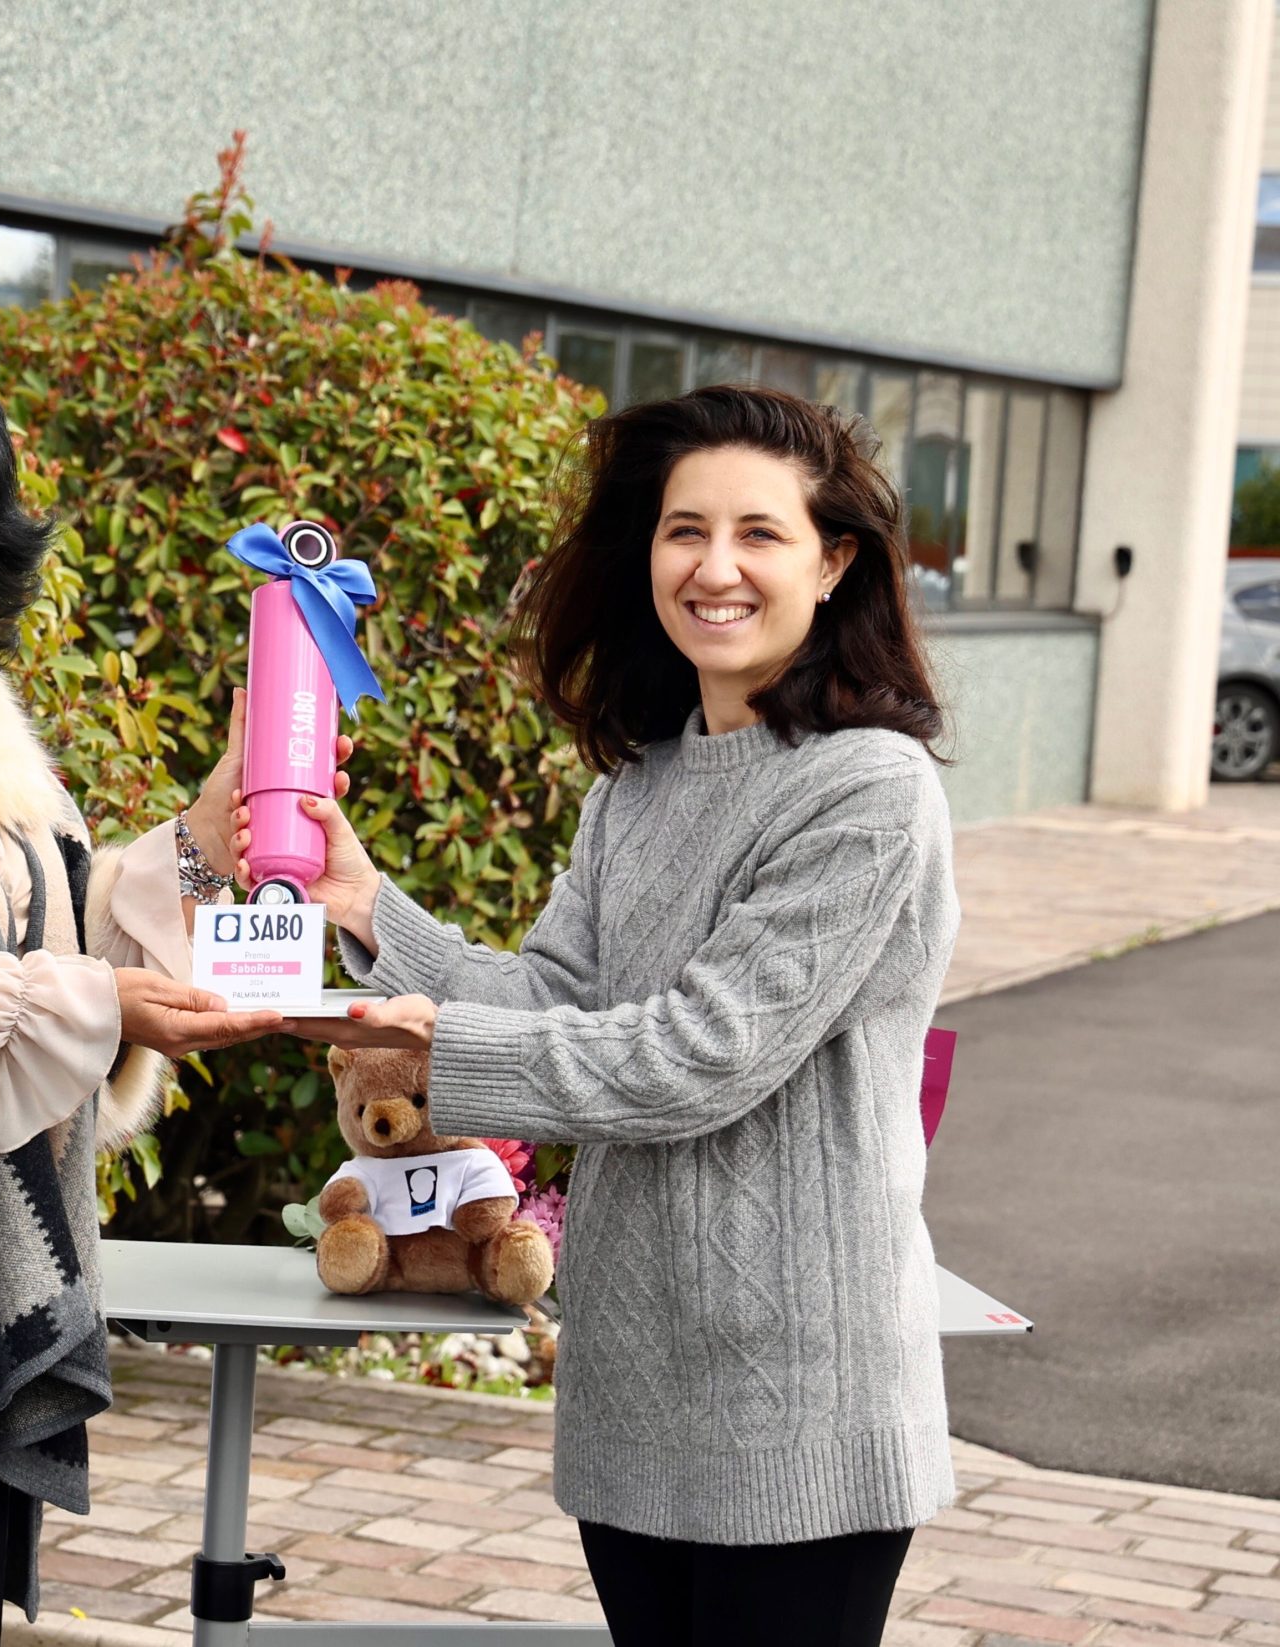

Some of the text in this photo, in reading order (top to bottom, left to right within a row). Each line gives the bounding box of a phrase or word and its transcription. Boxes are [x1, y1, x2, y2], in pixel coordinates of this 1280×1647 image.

[290, 690, 317, 735] SABO
[249, 913, 304, 942] SABO
[244, 951, 271, 960] Premio
[230, 963, 284, 974] SaboRosa
[232, 991, 281, 999] PALMIRA MURA
